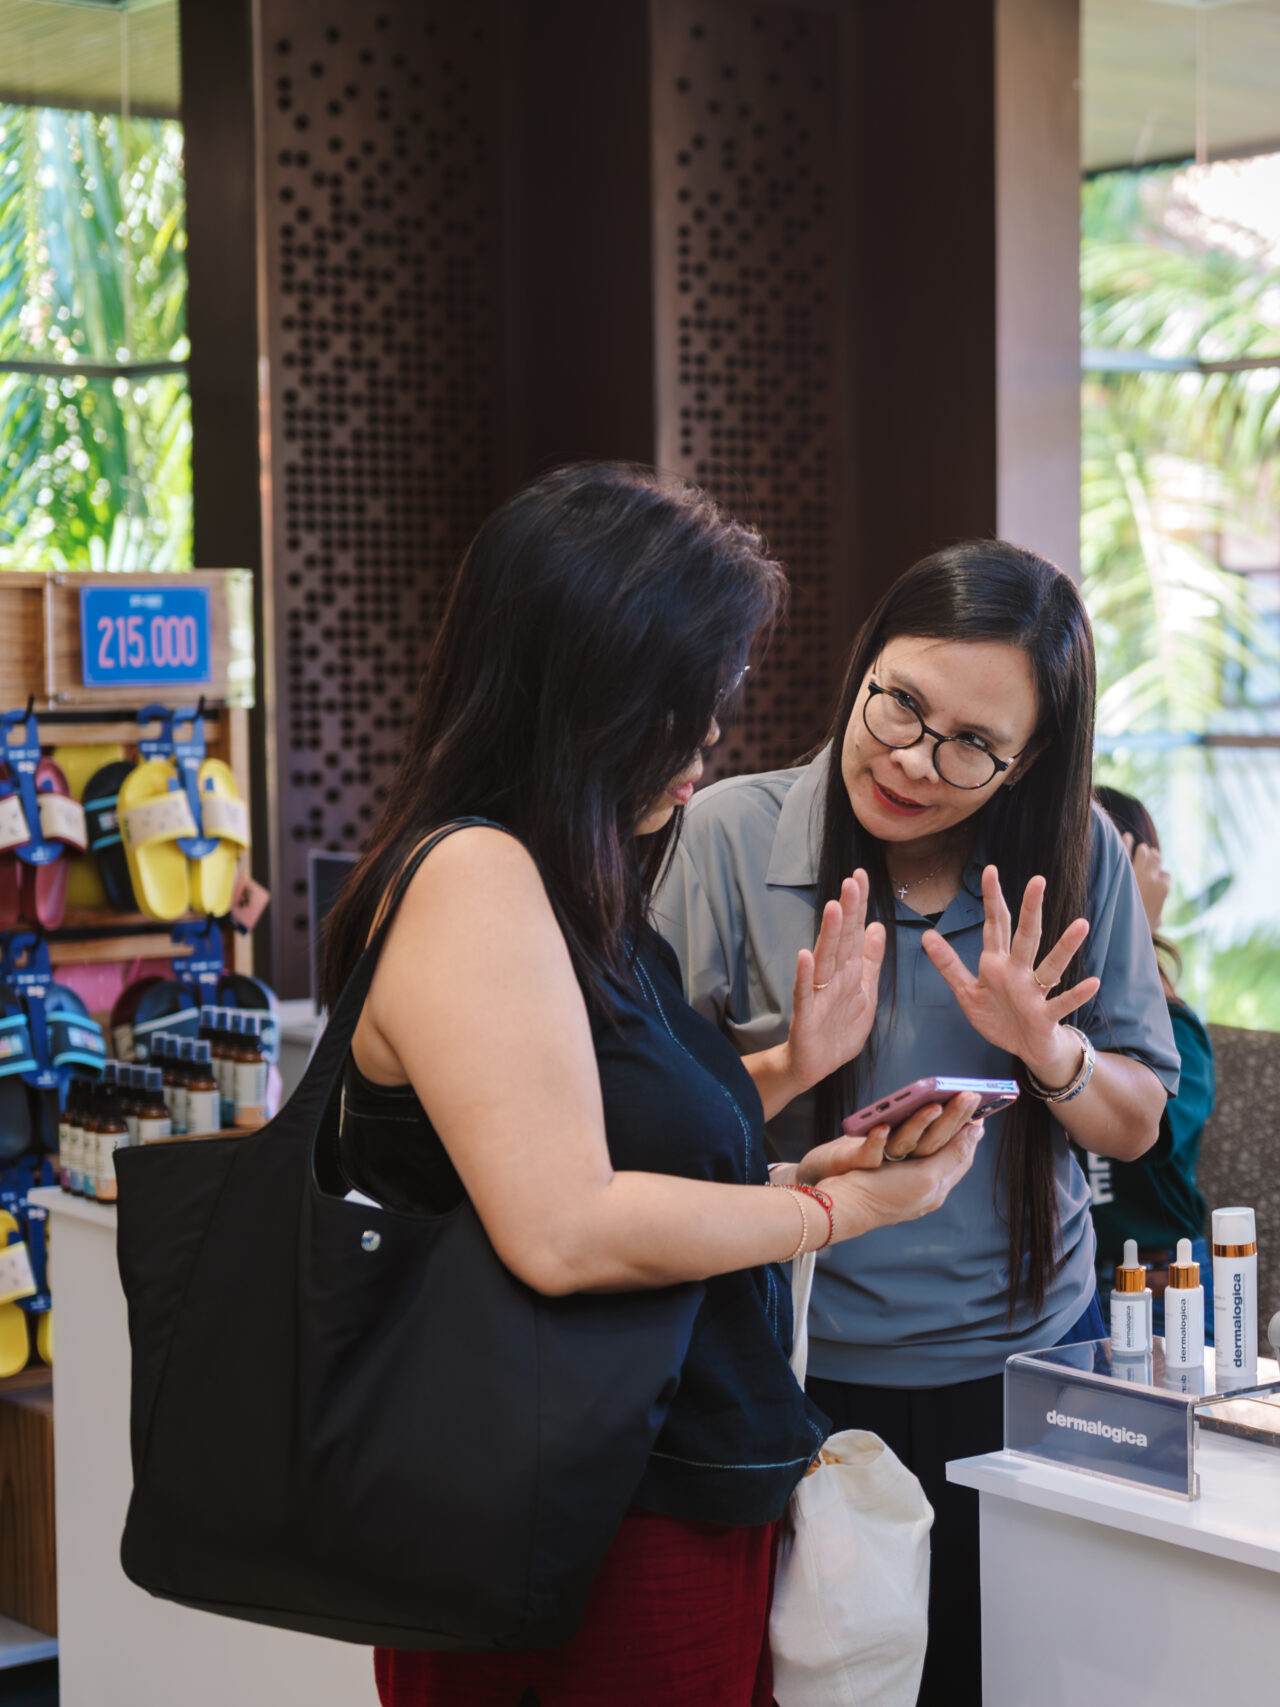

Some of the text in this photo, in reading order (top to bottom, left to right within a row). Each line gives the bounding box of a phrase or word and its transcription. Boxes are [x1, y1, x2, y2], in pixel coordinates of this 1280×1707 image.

[97, 615, 198, 669] 215.000
[1233, 1273, 1243, 1368] dermalogica
[1046, 1409, 1148, 1448] dermalogica
